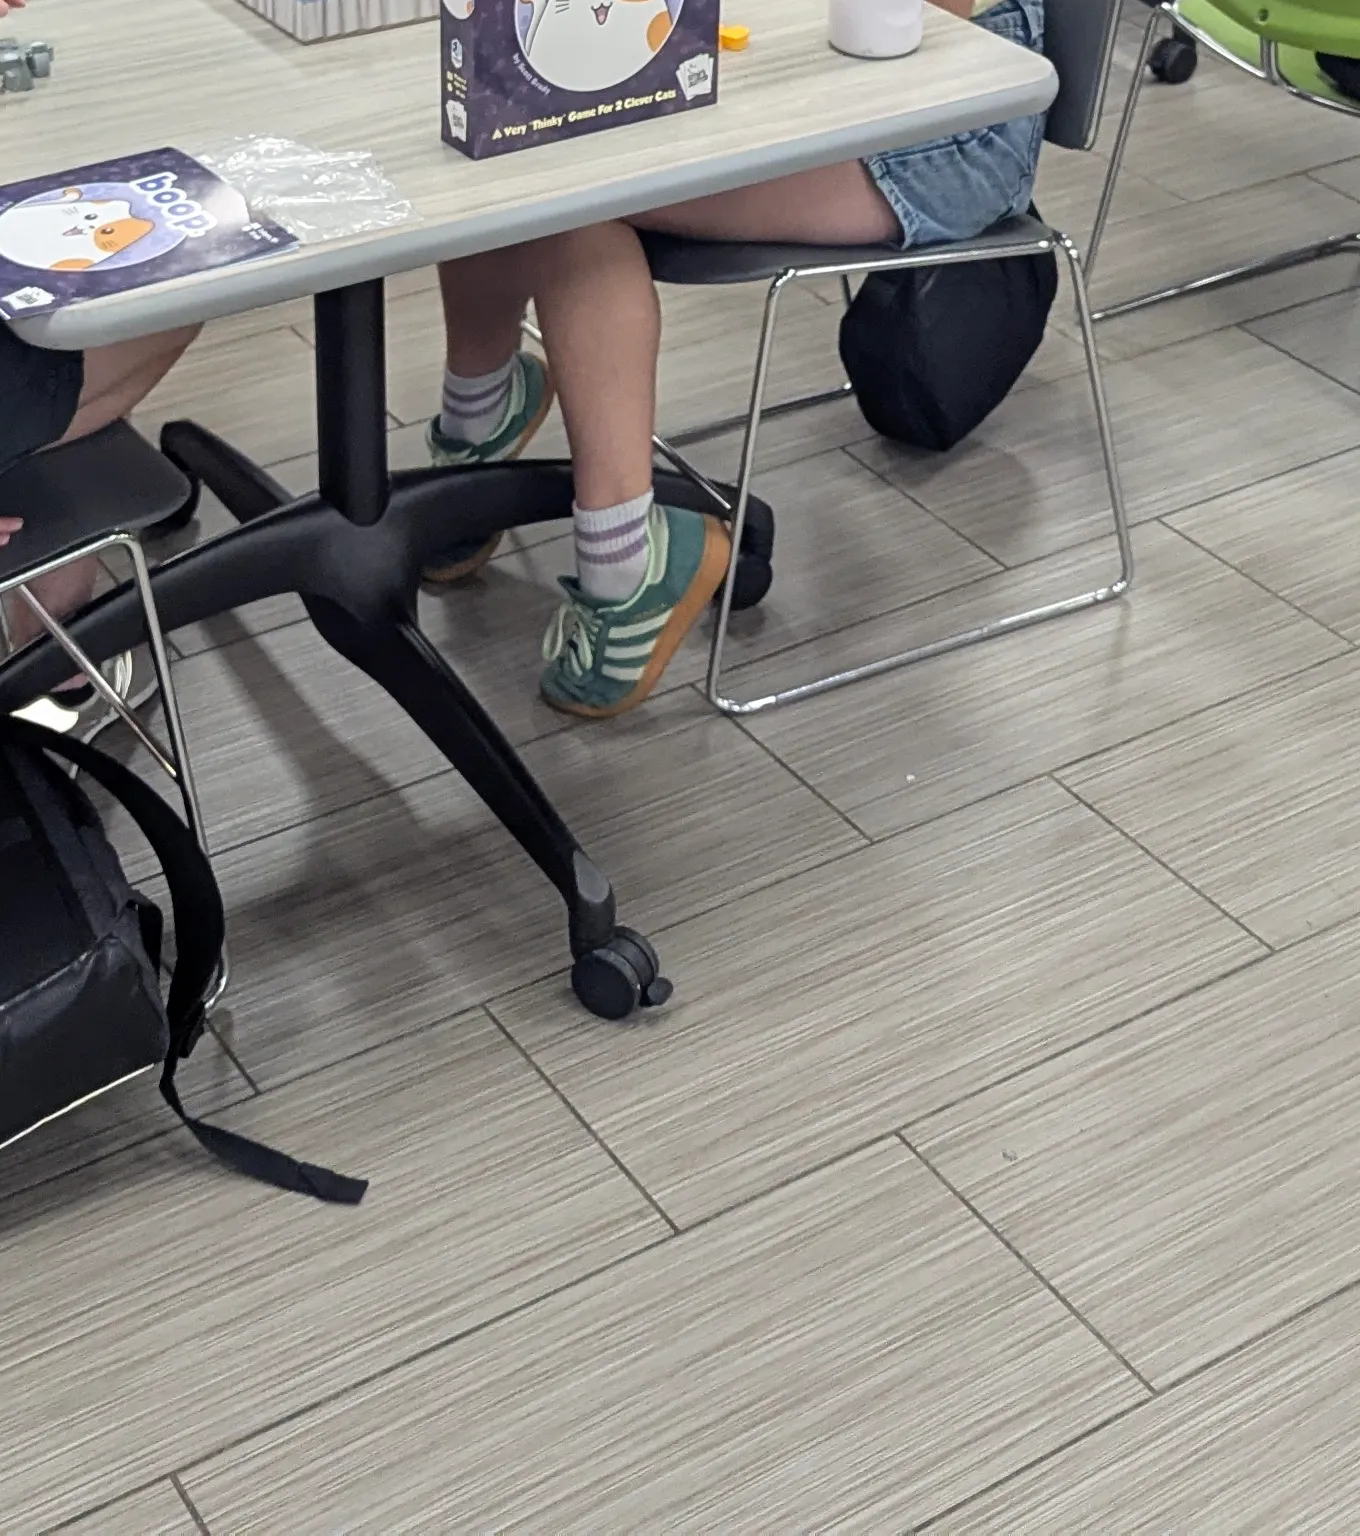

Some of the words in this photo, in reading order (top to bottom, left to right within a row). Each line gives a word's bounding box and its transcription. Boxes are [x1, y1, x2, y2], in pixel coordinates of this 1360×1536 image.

[503, 124, 527, 138] Very
[567, 108, 597, 123] Game
[597, 103, 614, 116] For
[614, 99, 623, 112] 2
[624, 94, 654, 110] Clever
[655, 88, 677, 102] Cats
